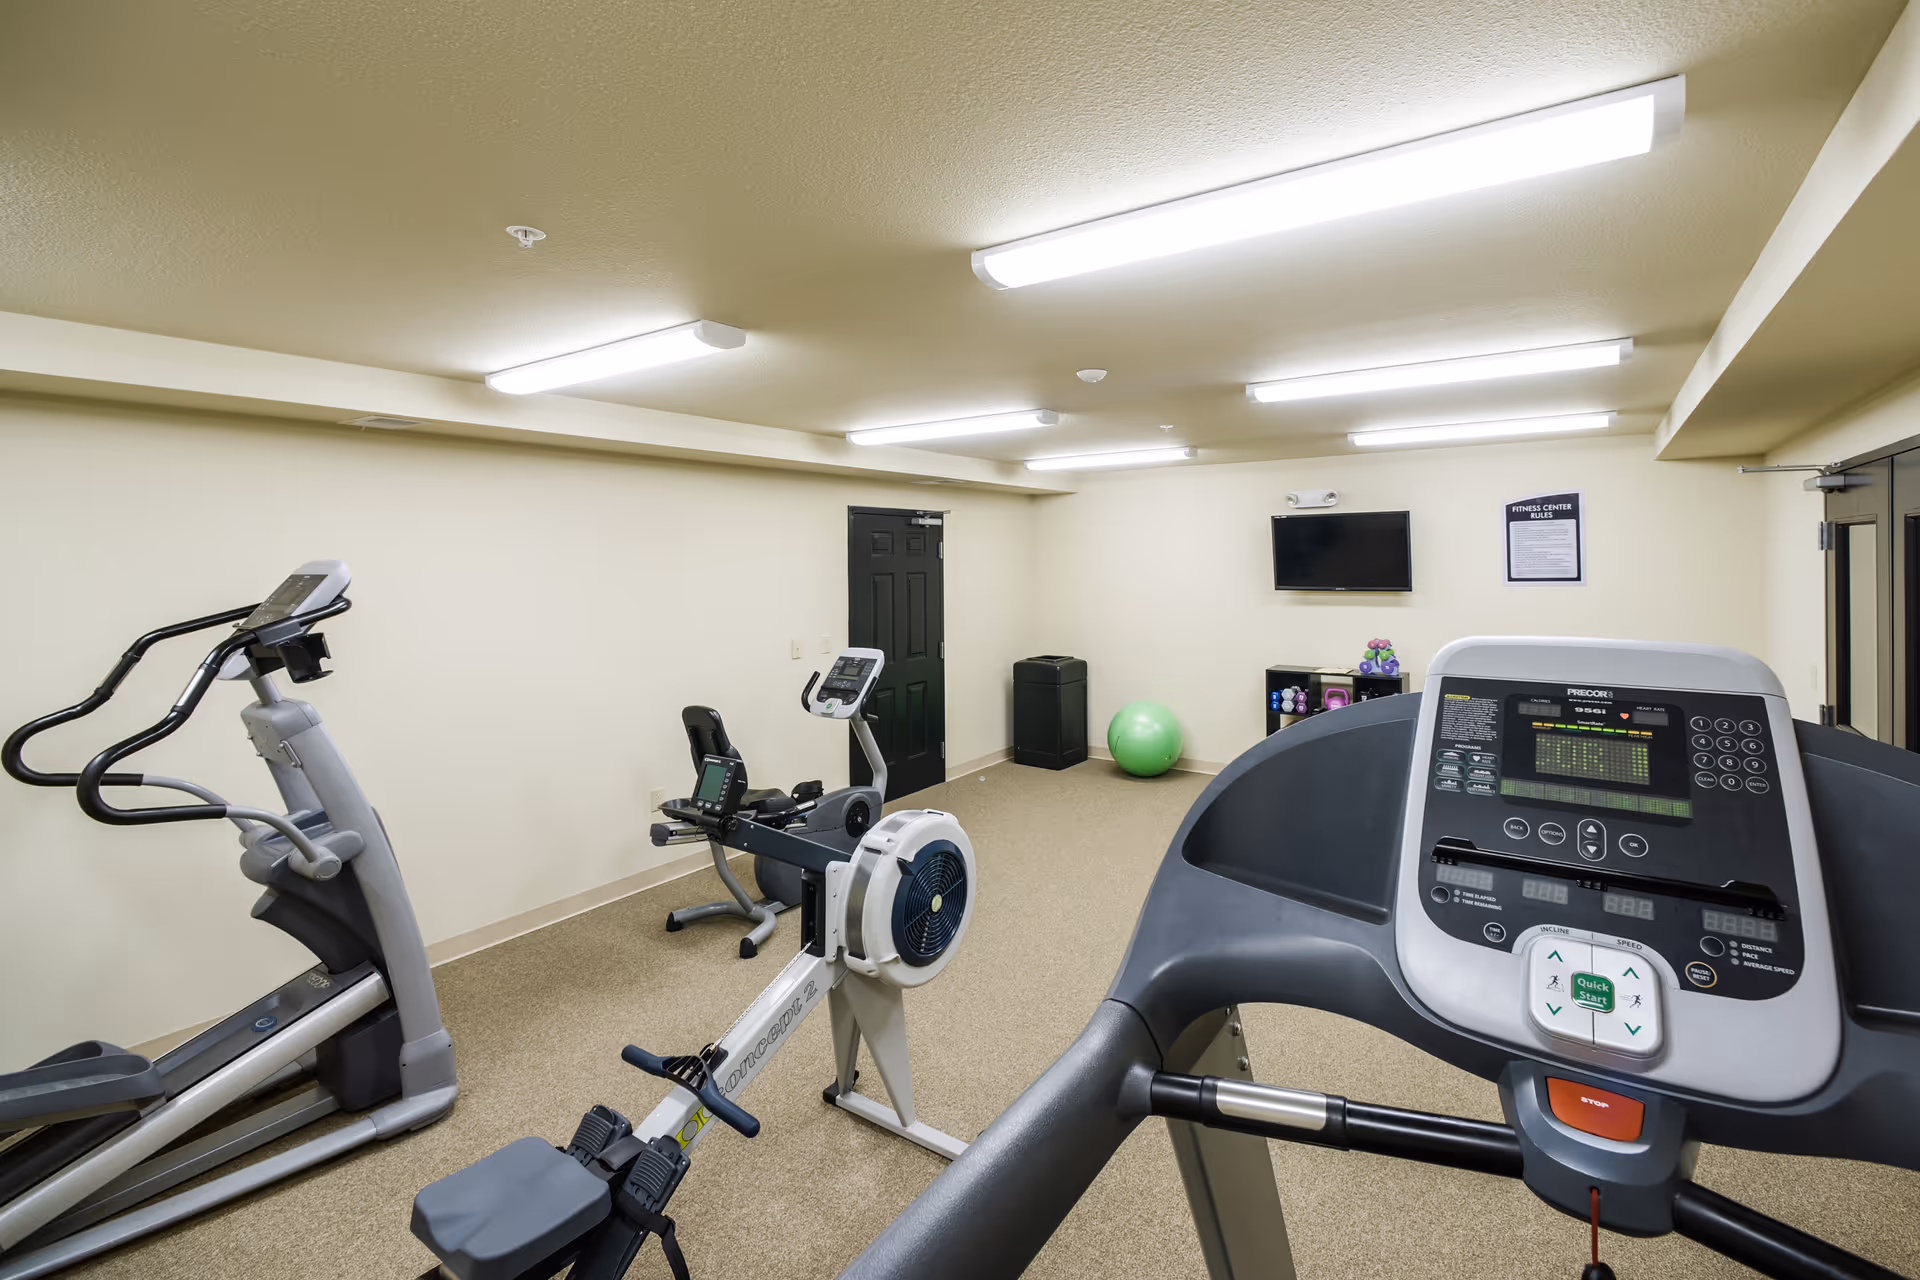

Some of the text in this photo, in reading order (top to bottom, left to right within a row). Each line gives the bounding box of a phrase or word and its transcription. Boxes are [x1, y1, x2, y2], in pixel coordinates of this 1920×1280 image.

[1567, 688, 1608, 698] PRECOR
[1722, 721, 1729, 729] 2
[1747, 723, 1754, 731] 3
[1454, 743, 1482, 751] PROGRAMS
[1749, 742, 1757, 750] 6
[1726, 758, 1733, 766] 8
[1751, 761, 1759, 769] 9
[1728, 778, 1736, 786] 0
[1540, 829, 1564, 838] OPTIONS
[1474, 894, 1497, 902] ELAPSED
[1474, 901, 1503, 911] REMAINING
[1540, 926, 1570, 935] INCLINE
[1617, 939, 1642, 950] SPEED
[1741, 943, 1773, 954] DISTANCE
[1742, 951, 1759, 960] PACE
[1743, 960, 1796, 975] AVERAGE SPEED
[1692, 973, 1711, 982] RESET
[1577, 977, 1609, 993] Quick
[803, 980, 818, 1003] 2
[1579, 990, 1608, 1006] Start
[1580, 1096, 1610, 1108] STOP
